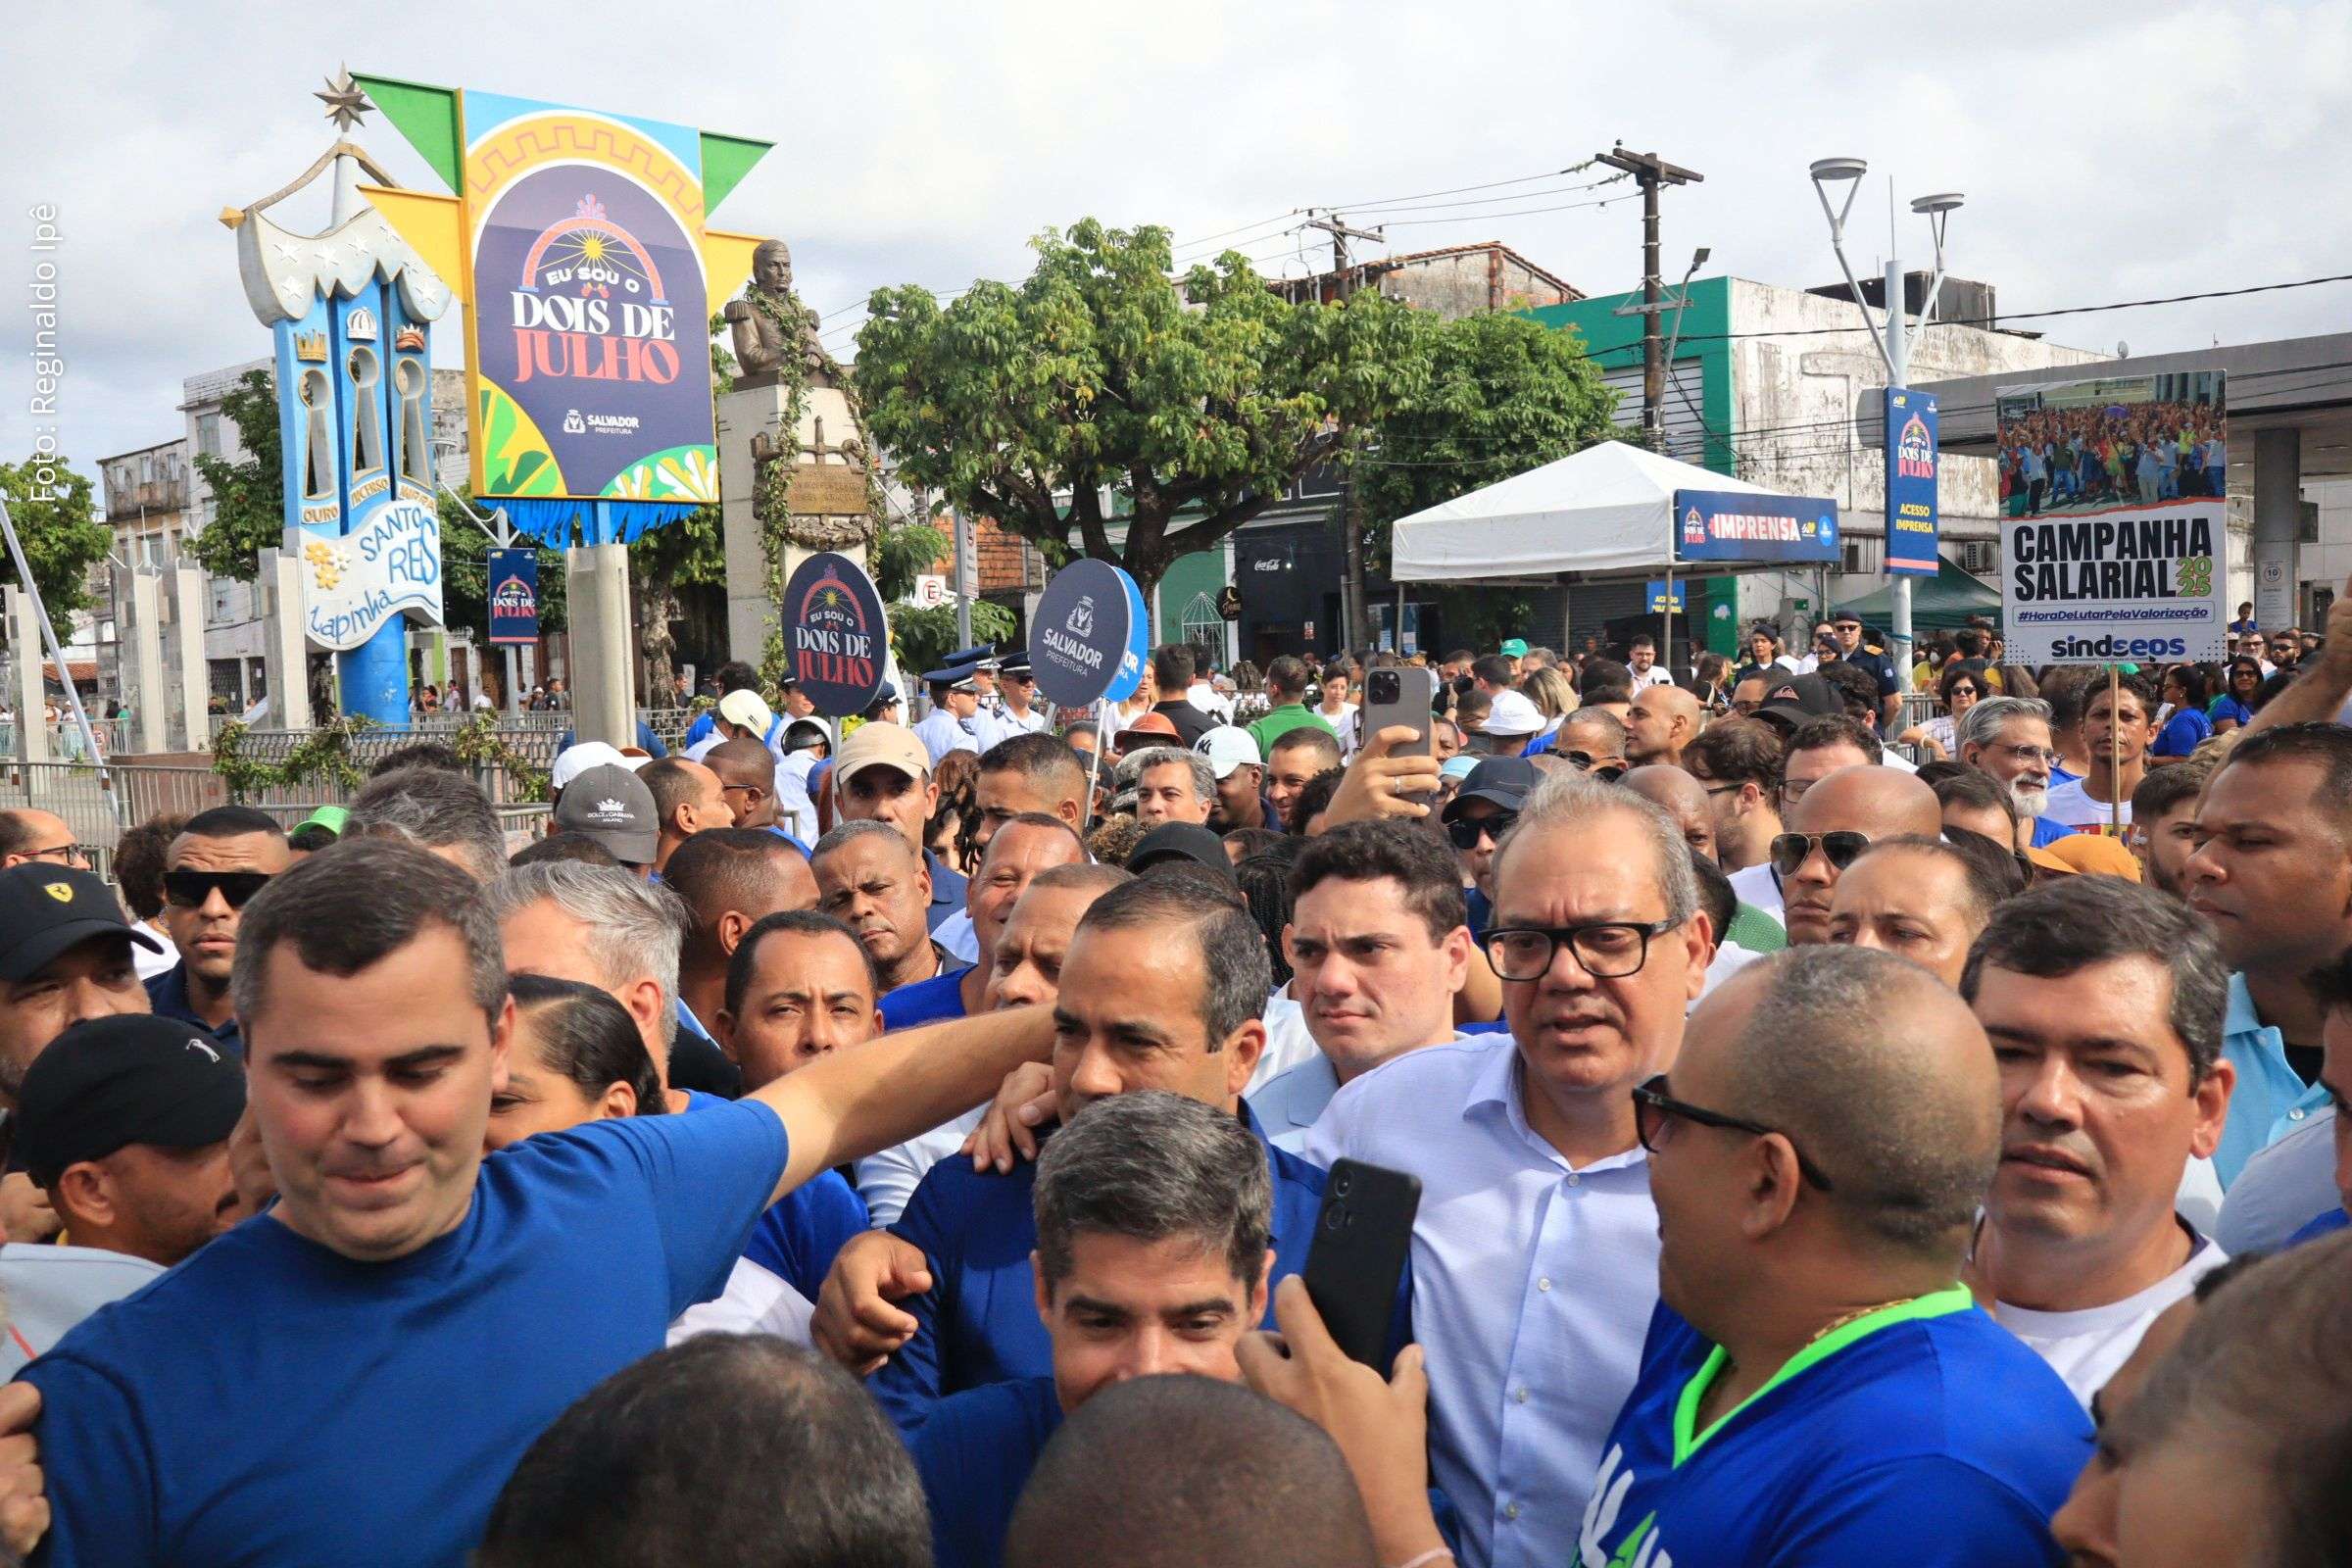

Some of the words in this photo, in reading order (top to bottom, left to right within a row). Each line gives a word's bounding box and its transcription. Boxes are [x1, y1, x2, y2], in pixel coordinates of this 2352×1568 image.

[546, 269, 572, 286] EU
[577, 267, 619, 285] SOU
[624, 278, 640, 293] O
[510, 291, 611, 335] DOIS
[620, 303, 675, 341] DE
[513, 328, 681, 385] JULHO
[587, 415, 640, 428] SALVADOR
[1897, 445, 1920, 461] DOIS
[303, 506, 338, 522] OURO
[1899, 504, 1930, 517] ACESSO
[1713, 514, 1802, 541] IMPRENSA
[1895, 519, 1934, 534] IMPRENSA
[2013, 517, 2213, 564] CAMPANHA
[2176, 556, 2213, 577] 20
[2014, 560, 2177, 601] SALARIAL
[2177, 576, 2213, 597] 25
[493, 597, 518, 608] DOIS
[809, 612, 822, 623] EU
[824, 611, 845, 622] SOU
[846, 617, 855, 627] O
[2018, 607, 2209, 622] #HoraDeLutarPelaValorização
[796, 626, 840, 655] DOIS
[845, 633, 871, 660] DE
[1042, 627, 1103, 669] SALVADOR
[797, 649, 875, 690] JULHO
[1046, 650, 1089, 676] PREFEITURA
